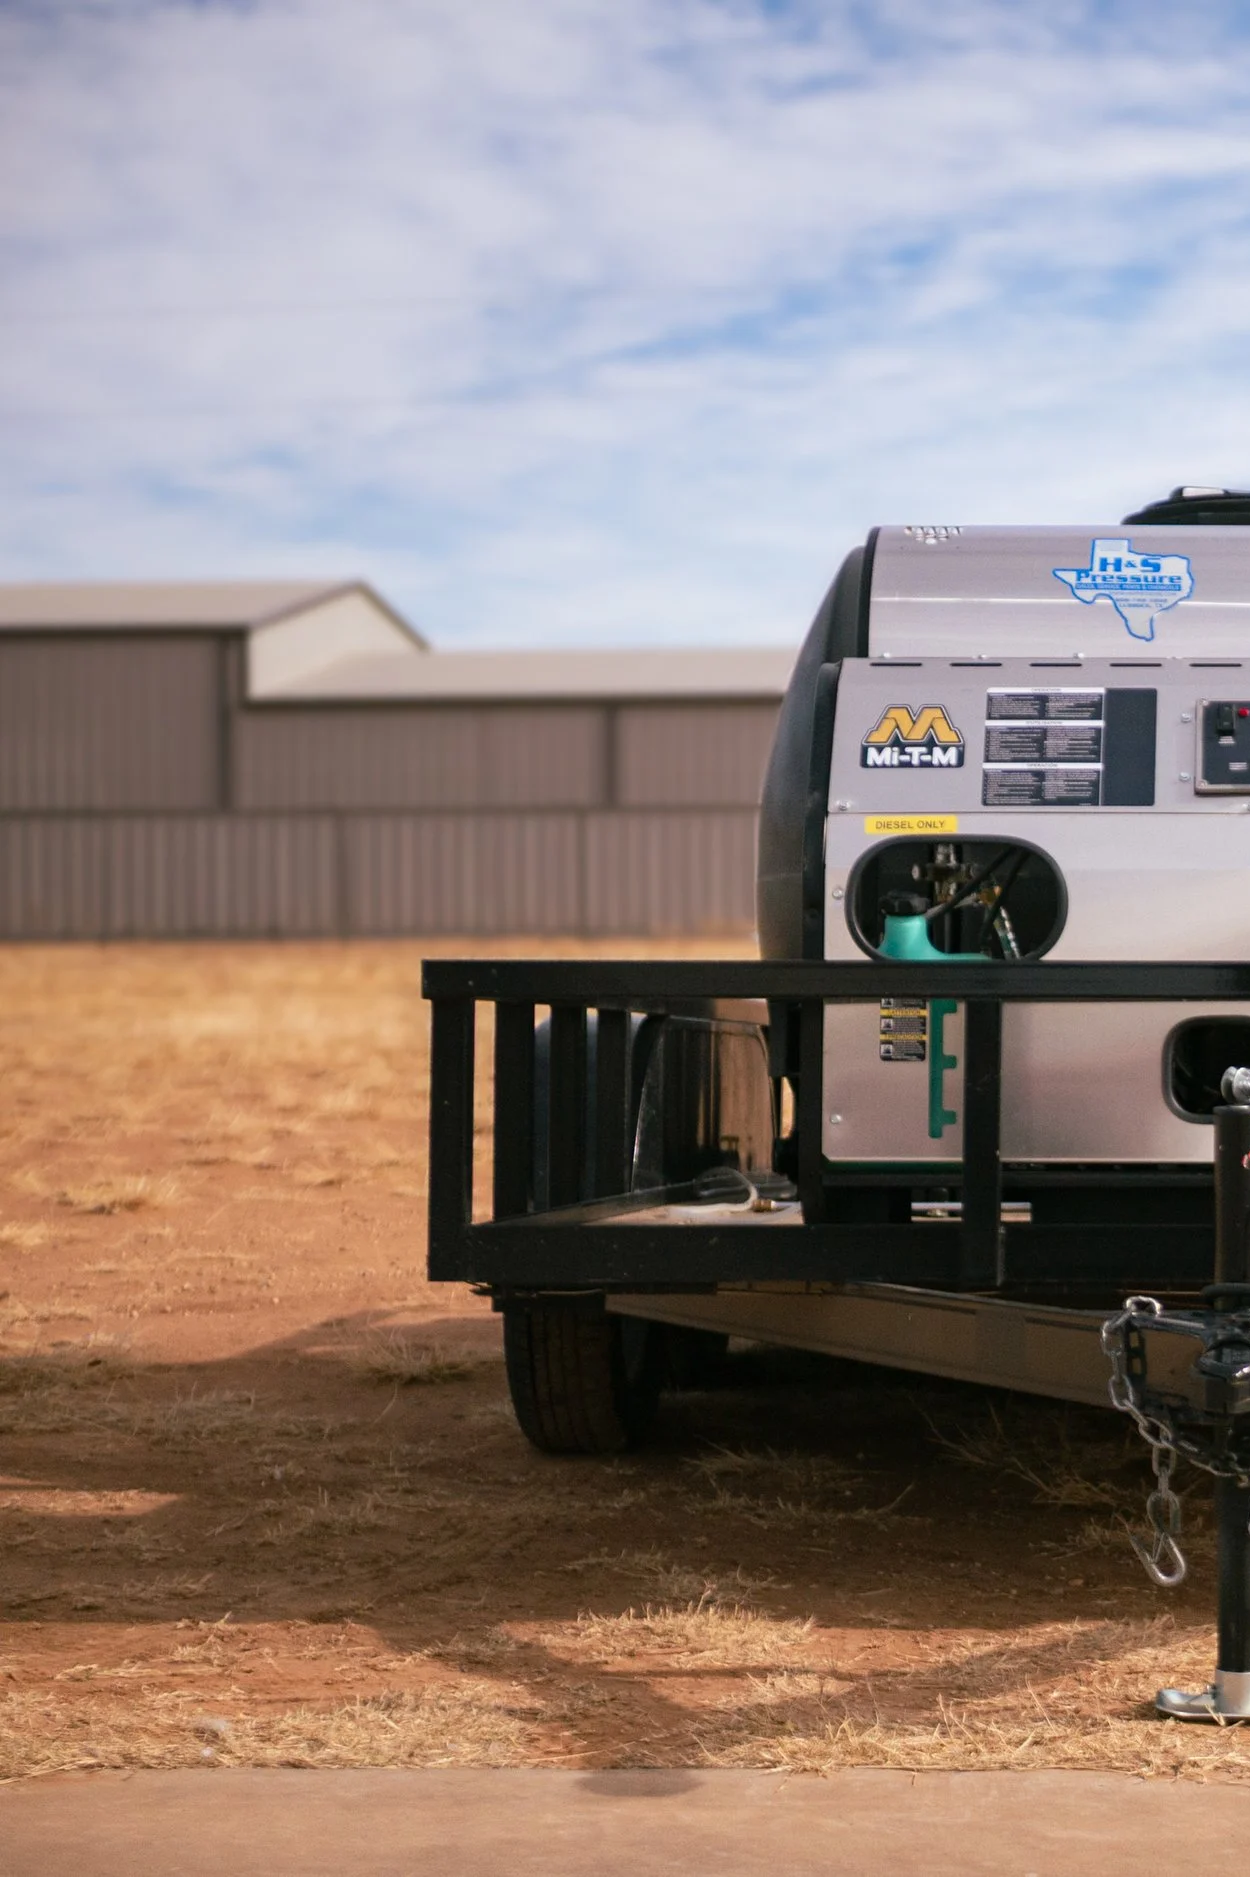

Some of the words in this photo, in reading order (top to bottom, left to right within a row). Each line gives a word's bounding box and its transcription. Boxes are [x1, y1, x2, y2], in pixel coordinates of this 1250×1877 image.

[1099, 557, 1161, 573] H&S
[1076, 570, 1182, 583] Pressure
[866, 747, 958, 766] Mi-T-M
[875, 821, 914, 830] DIESEL
[916, 820, 946, 829] ONLY
